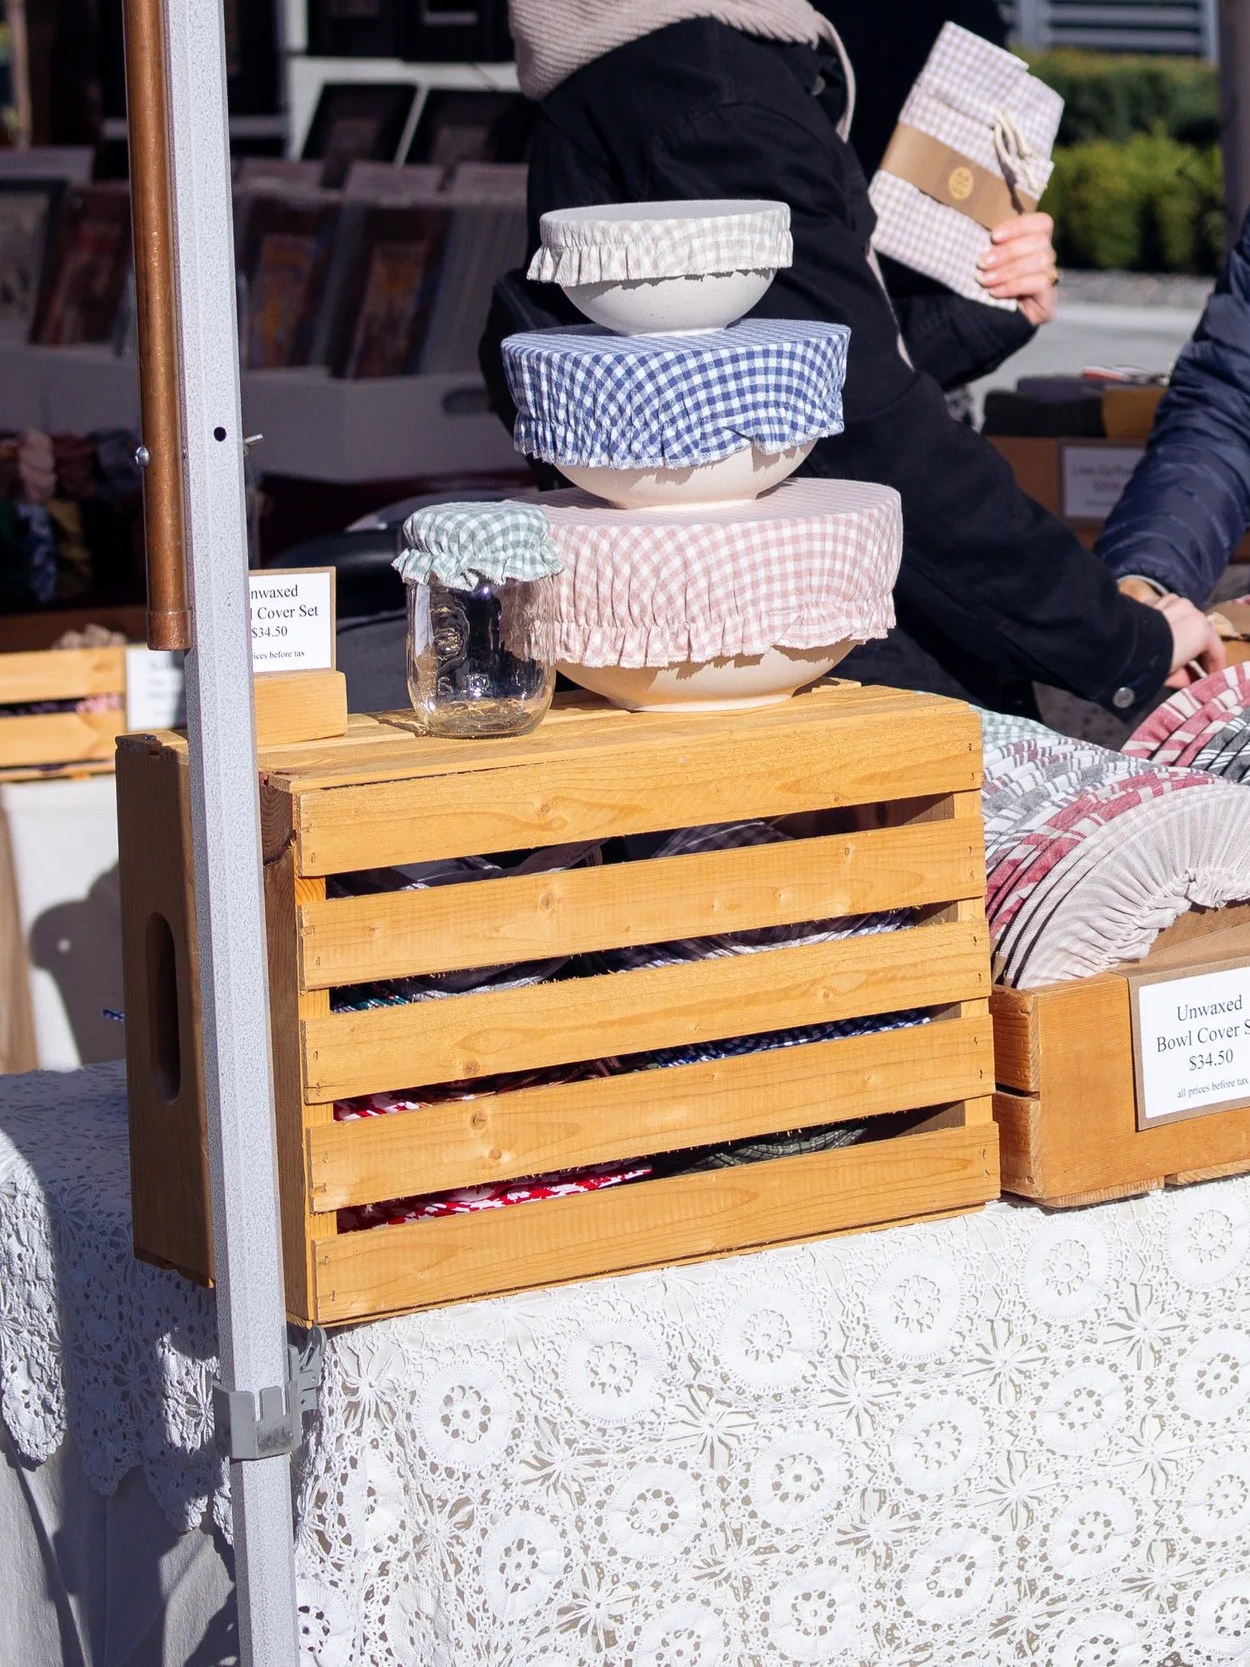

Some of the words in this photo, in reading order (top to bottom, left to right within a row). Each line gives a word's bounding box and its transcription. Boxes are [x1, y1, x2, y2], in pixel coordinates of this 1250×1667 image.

[250, 583, 299, 600] nwaxed
[256, 606, 296, 621] Cover
[298, 604, 320, 618] Set
[251, 625, 288, 639] $34.50
[269, 650, 293, 659] before
[294, 649, 306, 658] tax
[1176, 994, 1244, 1022] Unwaxed
[1156, 1030, 1193, 1053] Bowl
[1197, 1024, 1240, 1044] Cover
[1188, 1048, 1234, 1071] $34.50
[1176, 1088, 1187, 1099] all
[1188, 1085, 1211, 1099] prices
[1211, 1078, 1236, 1092] before
[1236, 1077, 1249, 1086] tax
